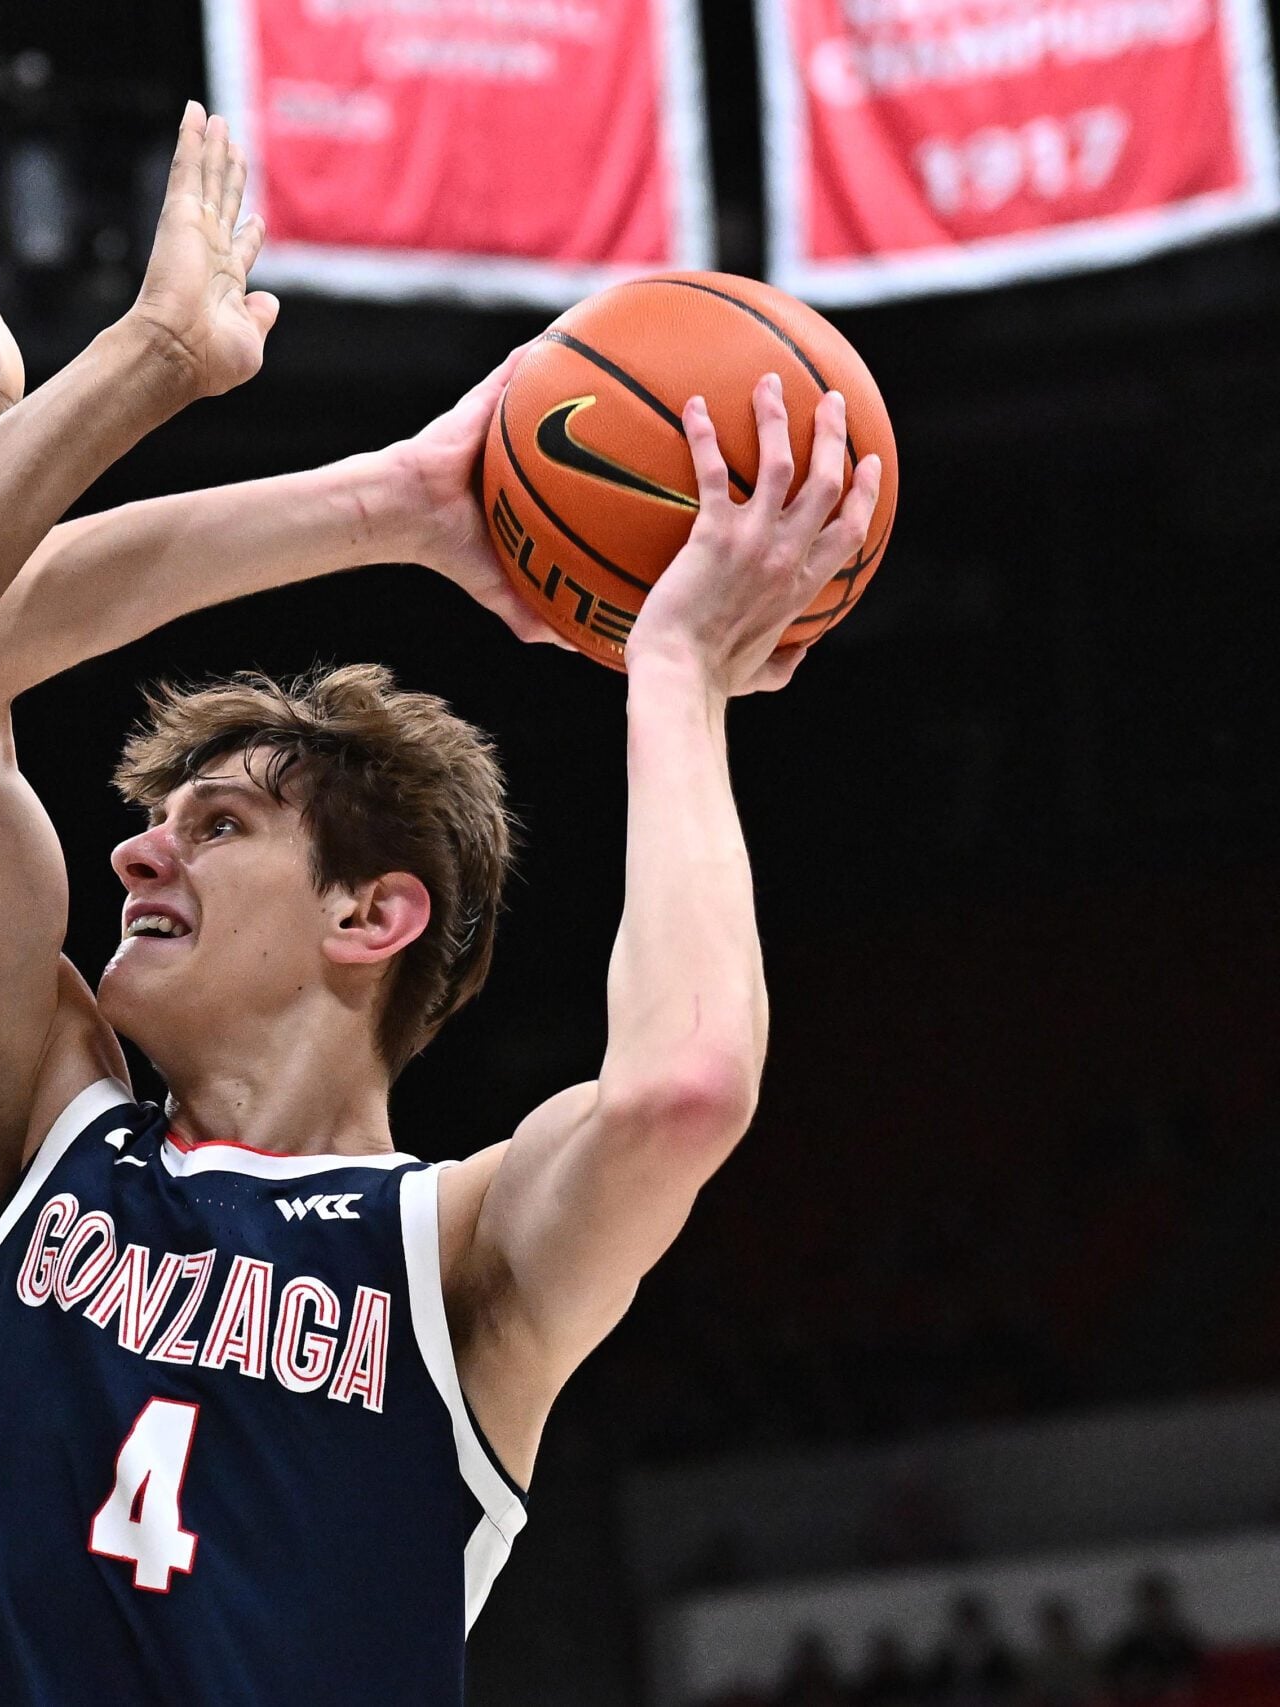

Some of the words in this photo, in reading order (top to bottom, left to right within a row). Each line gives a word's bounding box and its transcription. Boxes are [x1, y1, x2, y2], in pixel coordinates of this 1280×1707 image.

[493, 487, 639, 644] ELITE
[274, 1193, 364, 1222] WCC
[17, 1192, 392, 1414] GONZAGA
[87, 1395, 200, 1594] 4
